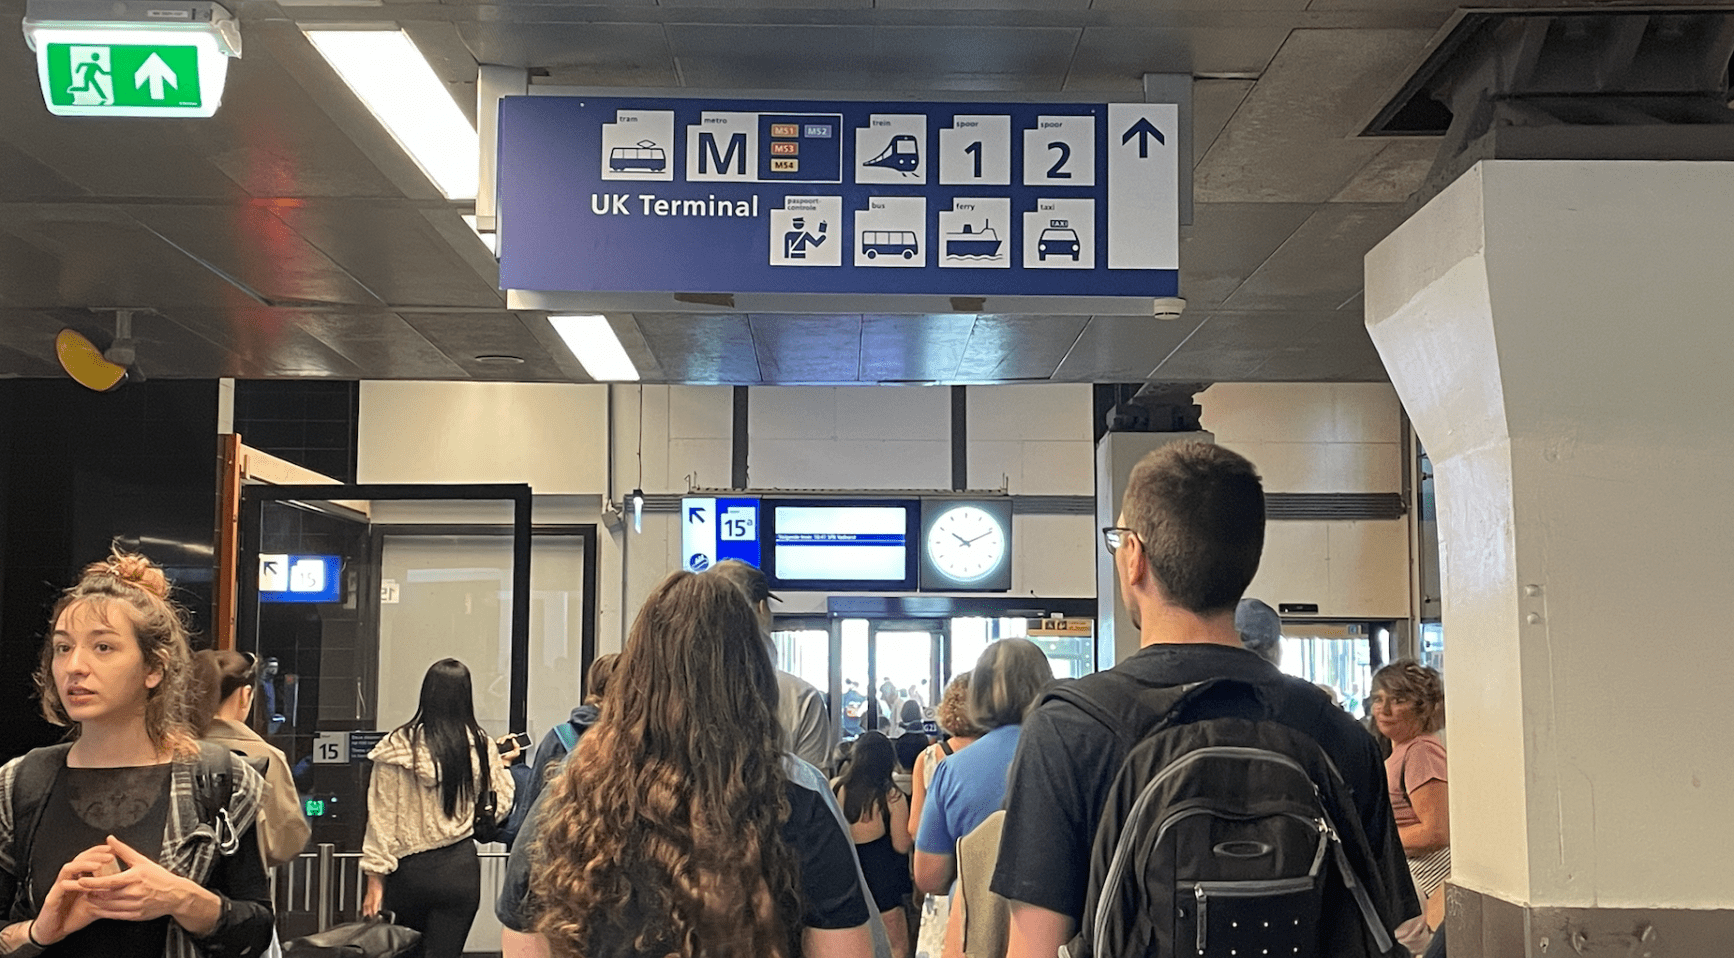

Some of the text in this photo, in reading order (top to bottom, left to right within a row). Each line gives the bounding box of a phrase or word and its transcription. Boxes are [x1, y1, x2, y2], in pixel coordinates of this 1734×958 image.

[956, 121, 979, 129] spoor
[774, 126, 794, 135] M51
[807, 127, 827, 135] M52
[774, 144, 794, 153] M53
[698, 132, 747, 175] M
[964, 141, 982, 178] 1
[1046, 141, 1072, 179] 2
[774, 161, 794, 169] M54
[591, 193, 758, 217] UK Terminal
[956, 202, 976, 211] ferry
[319, 743, 339, 760] 15
